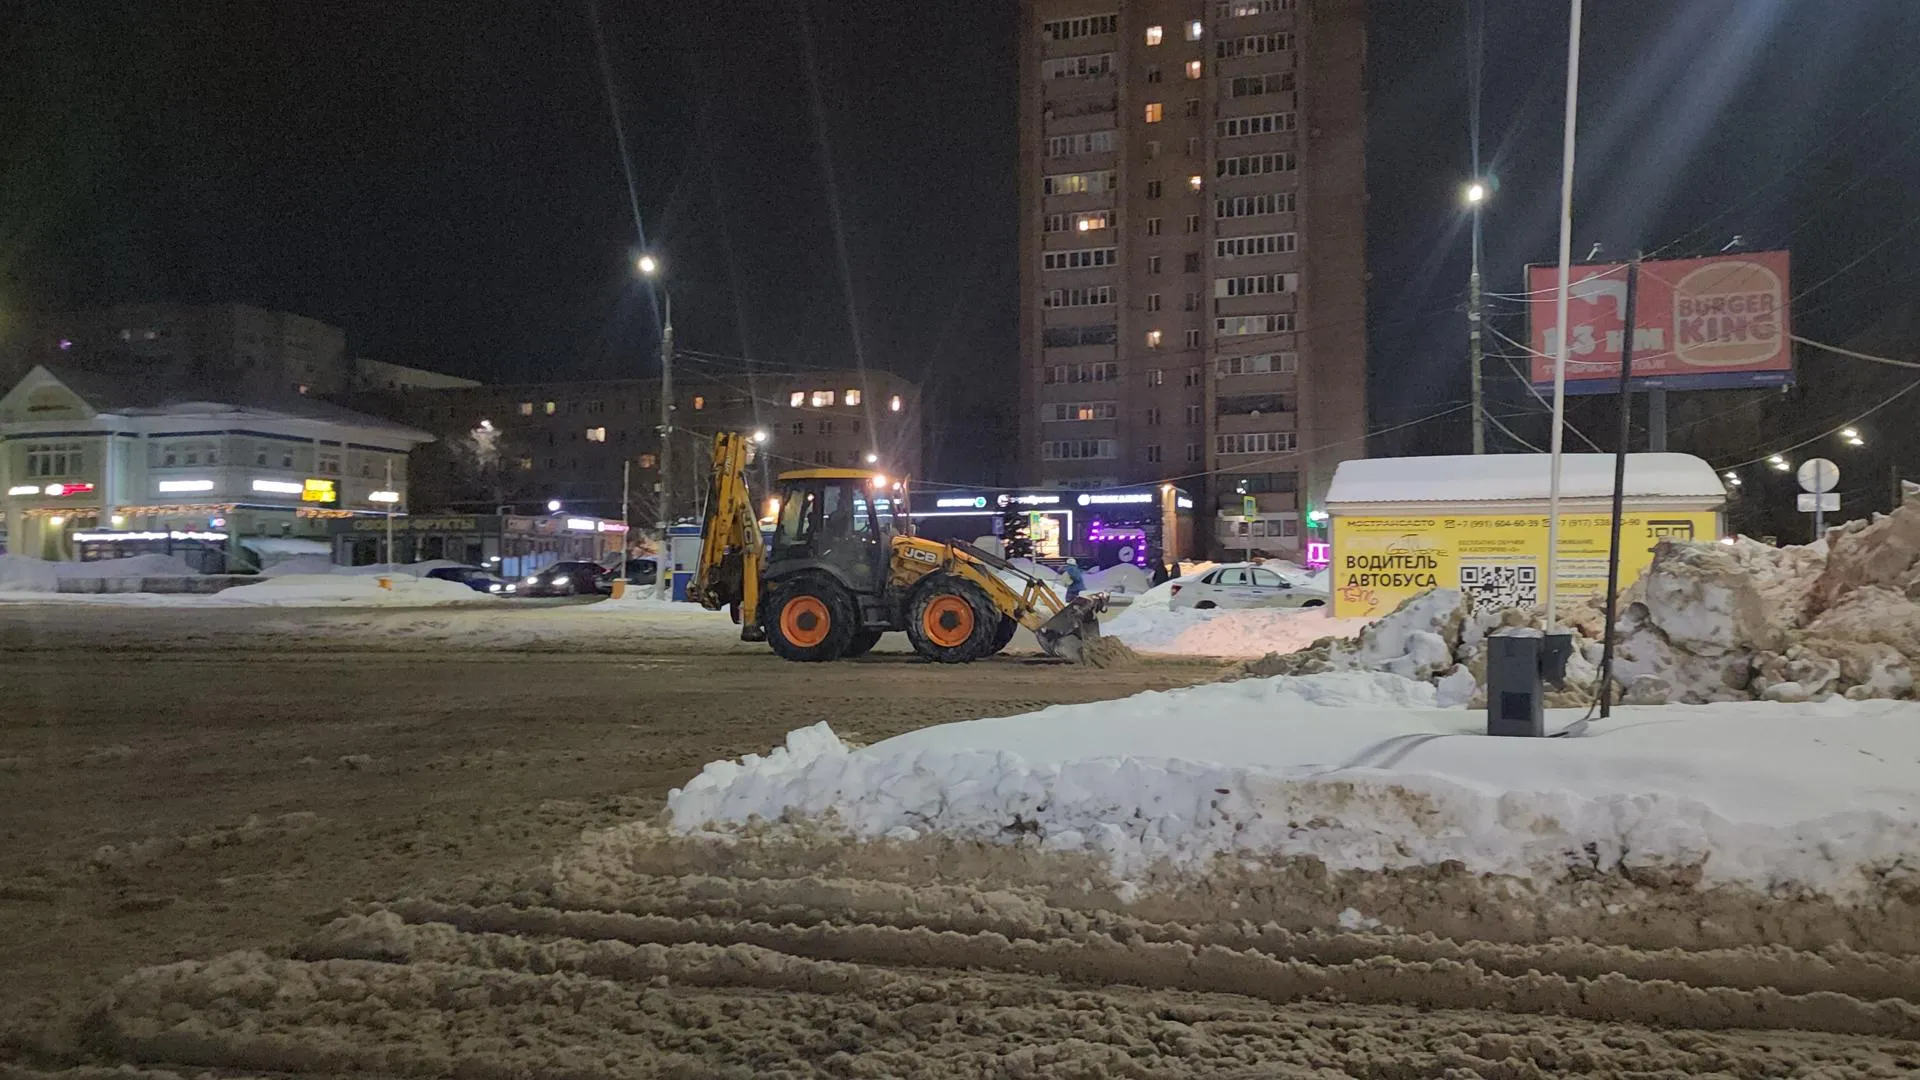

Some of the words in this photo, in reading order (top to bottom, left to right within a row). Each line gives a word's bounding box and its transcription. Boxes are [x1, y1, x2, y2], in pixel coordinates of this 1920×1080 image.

[1679, 293, 1774, 317] BURGER
[1680, 315, 1778, 345] KING
[904, 548, 937, 563] JCB
[1346, 555, 1438, 571] ВОДИТЕЛЬ
[1347, 573, 1438, 588] АВТОБУСА
